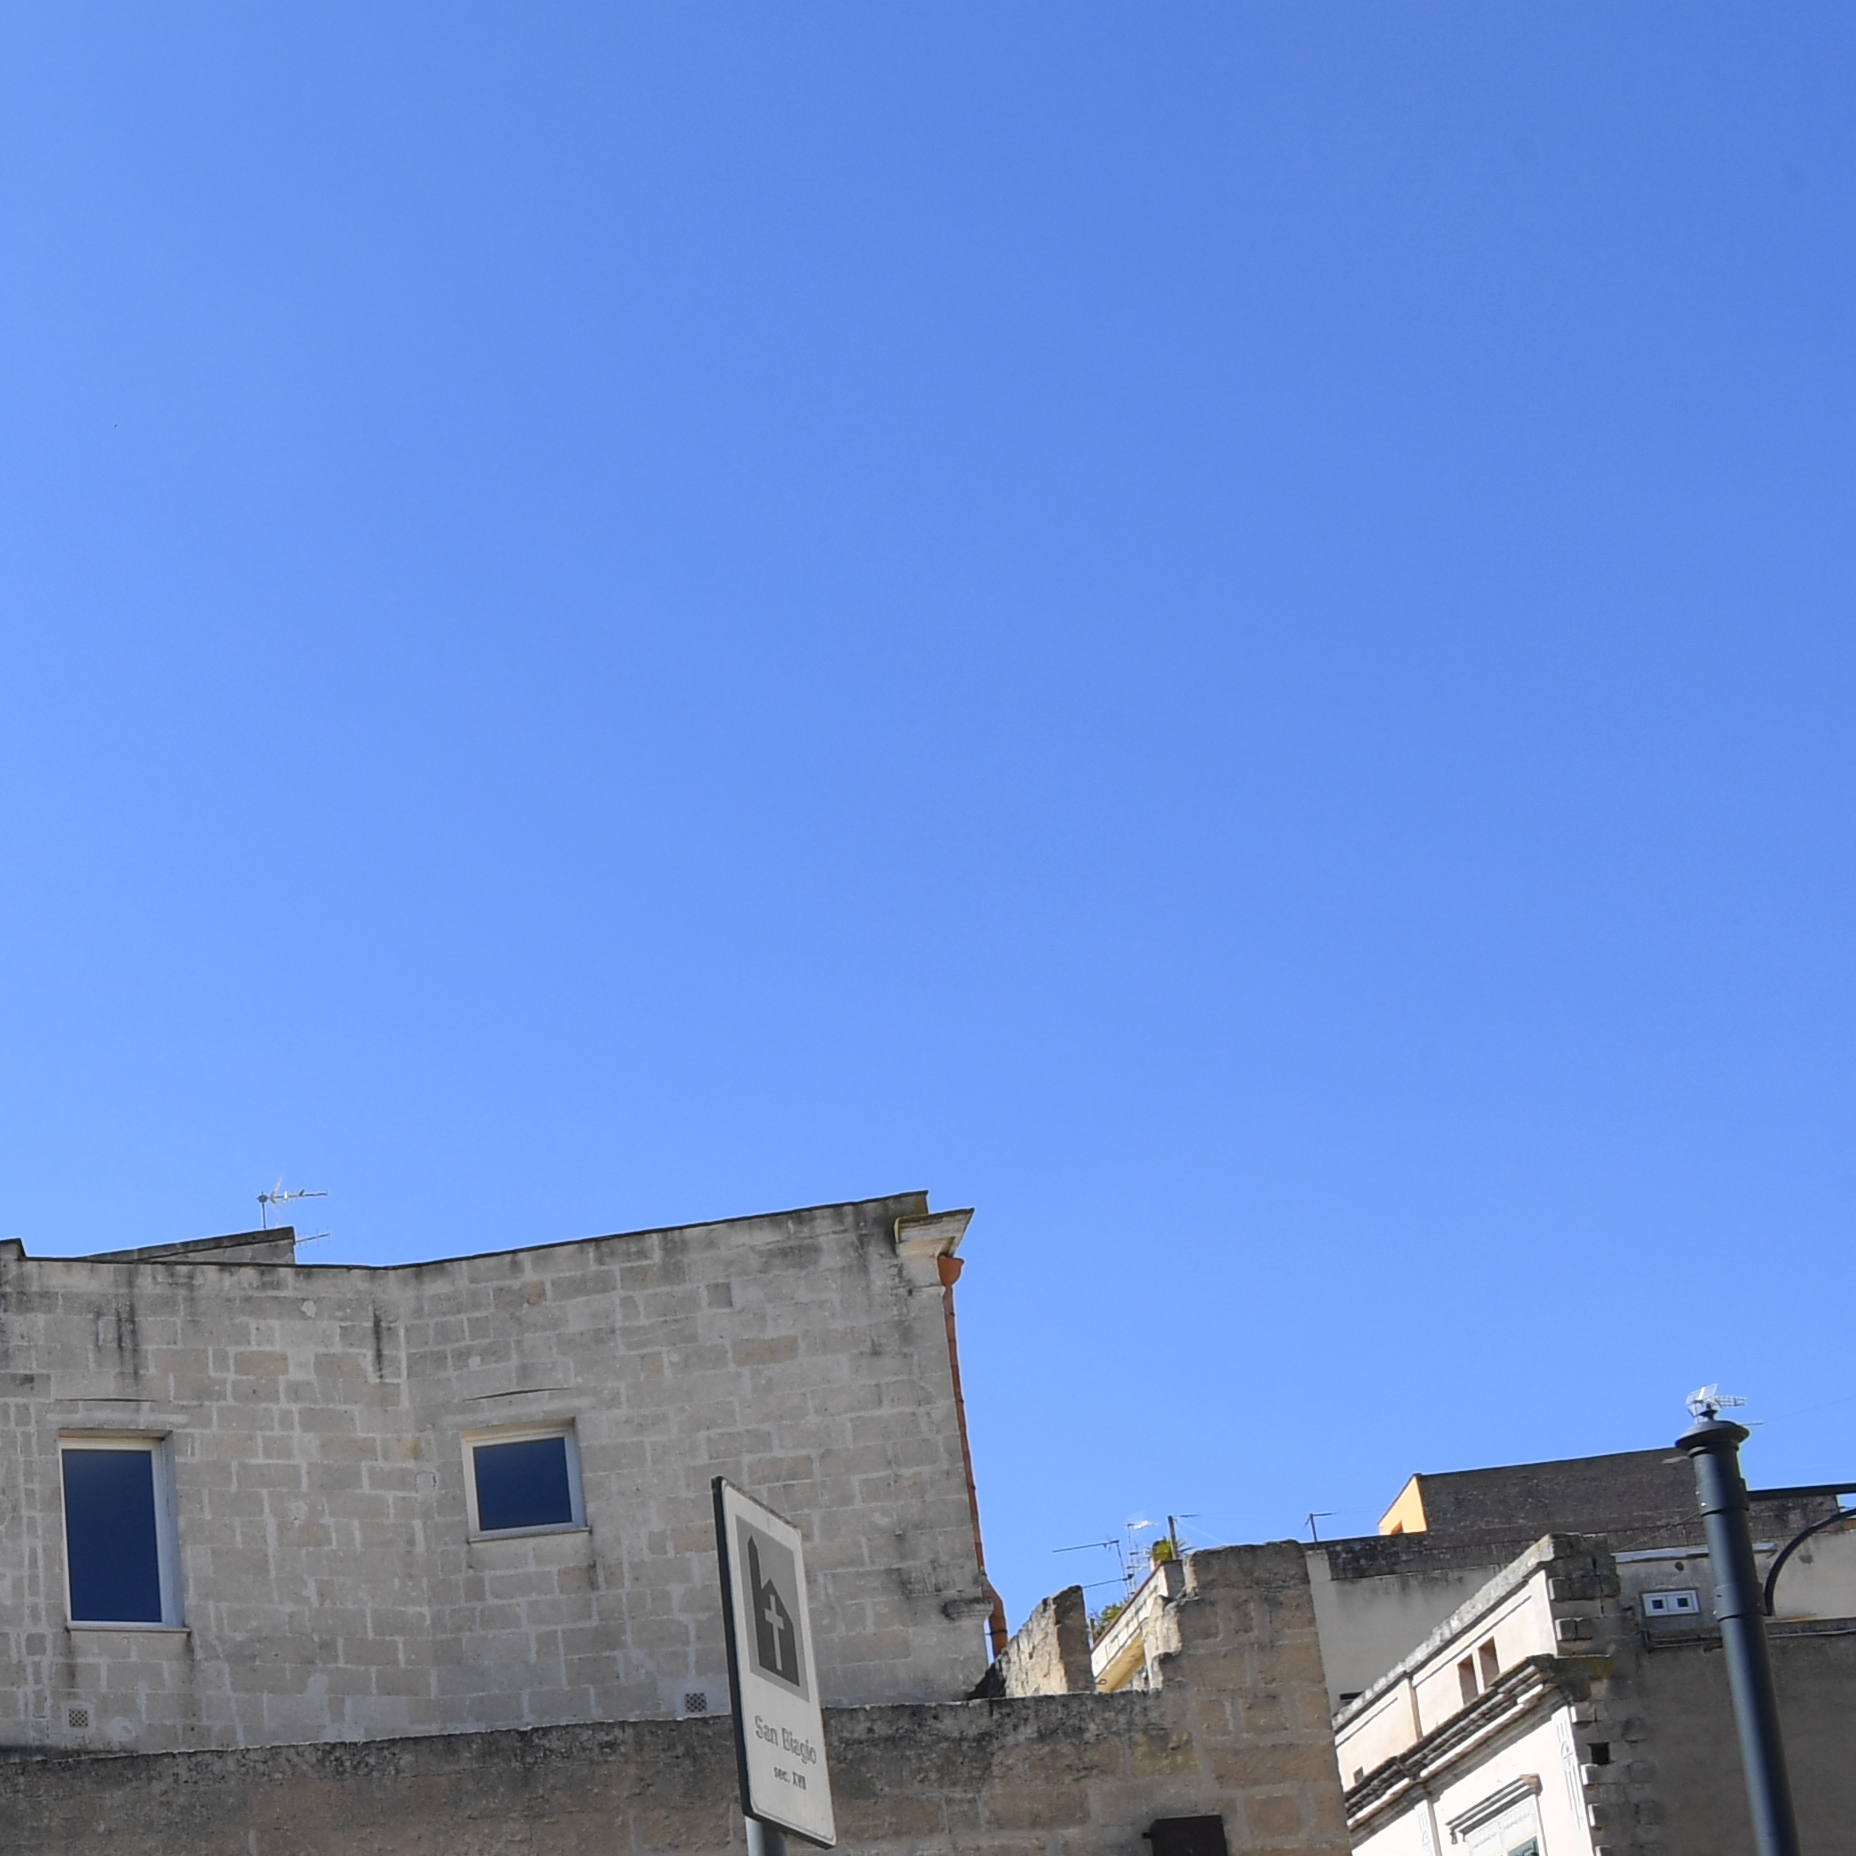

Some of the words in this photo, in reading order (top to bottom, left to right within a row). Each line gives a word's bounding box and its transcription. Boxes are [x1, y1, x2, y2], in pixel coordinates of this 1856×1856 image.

[755, 1715, 778, 1746] San
[781, 1727, 817, 1764] Biagio
[774, 1766, 790, 1783] sec.
